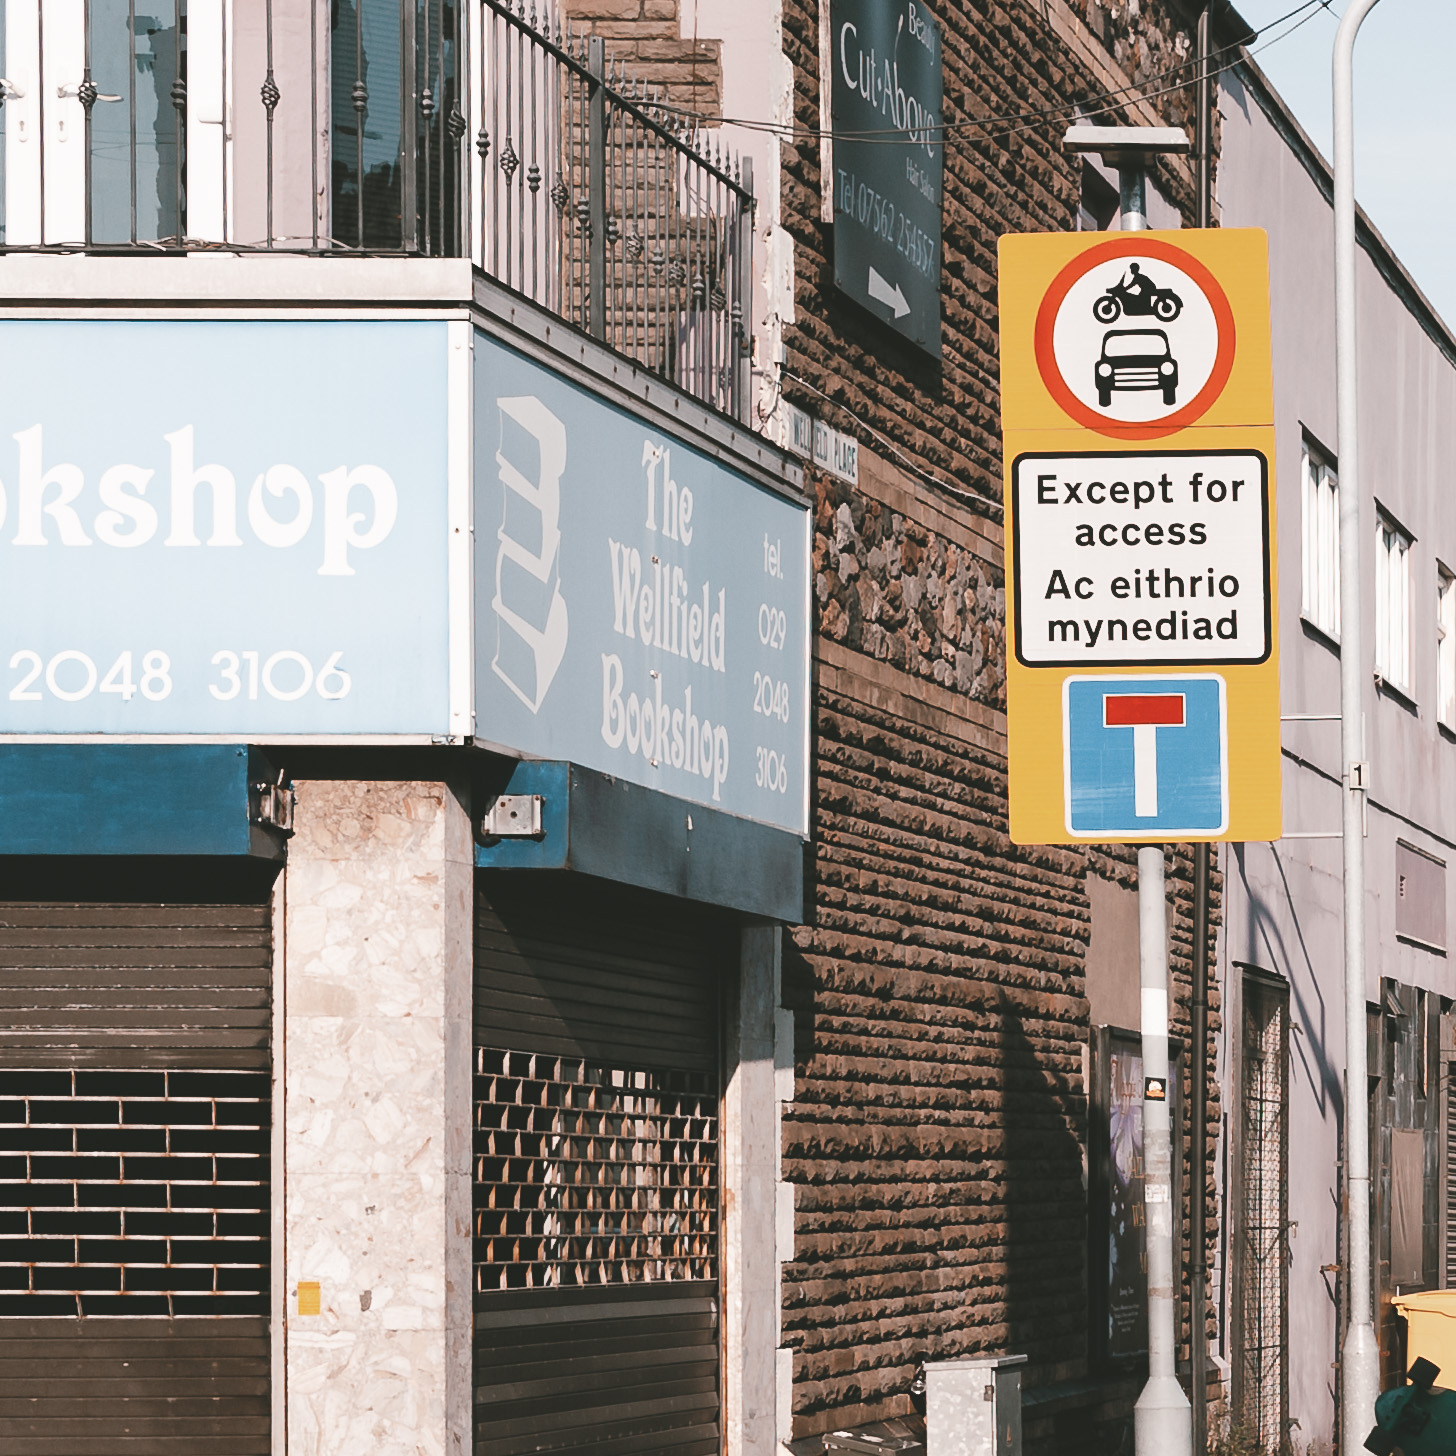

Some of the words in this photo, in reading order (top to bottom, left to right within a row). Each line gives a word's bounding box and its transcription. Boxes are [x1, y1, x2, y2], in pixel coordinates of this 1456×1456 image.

[838, 168, 855, 218] Tel
[858, 182, 895, 242] 07562
[793, 412, 828, 462] WELLIELD
[834, 436, 856, 478] PLACE
[0, 423, 398, 576] kshop
[641, 439, 694, 547] The
[1037, 473, 1174, 510] Except
[1189, 472, 1245, 503] for
[762, 532, 784, 580] tel.
[1075, 522, 1208, 547] access
[608, 536, 726, 673] Wellfield
[1044, 569, 1095, 600] Ac
[1110, 567, 1240, 599] eithrio
[758, 603, 787, 651] 029
[1048, 609, 1239, 648] mynediad
[9, 649, 173, 701] 2048
[208, 649, 352, 701] 3106
[752, 670, 790, 724] 2048
[600, 652, 729, 802] Bookshop
[755, 745, 788, 794] 3106
[1353, 764, 1362, 786] 1
